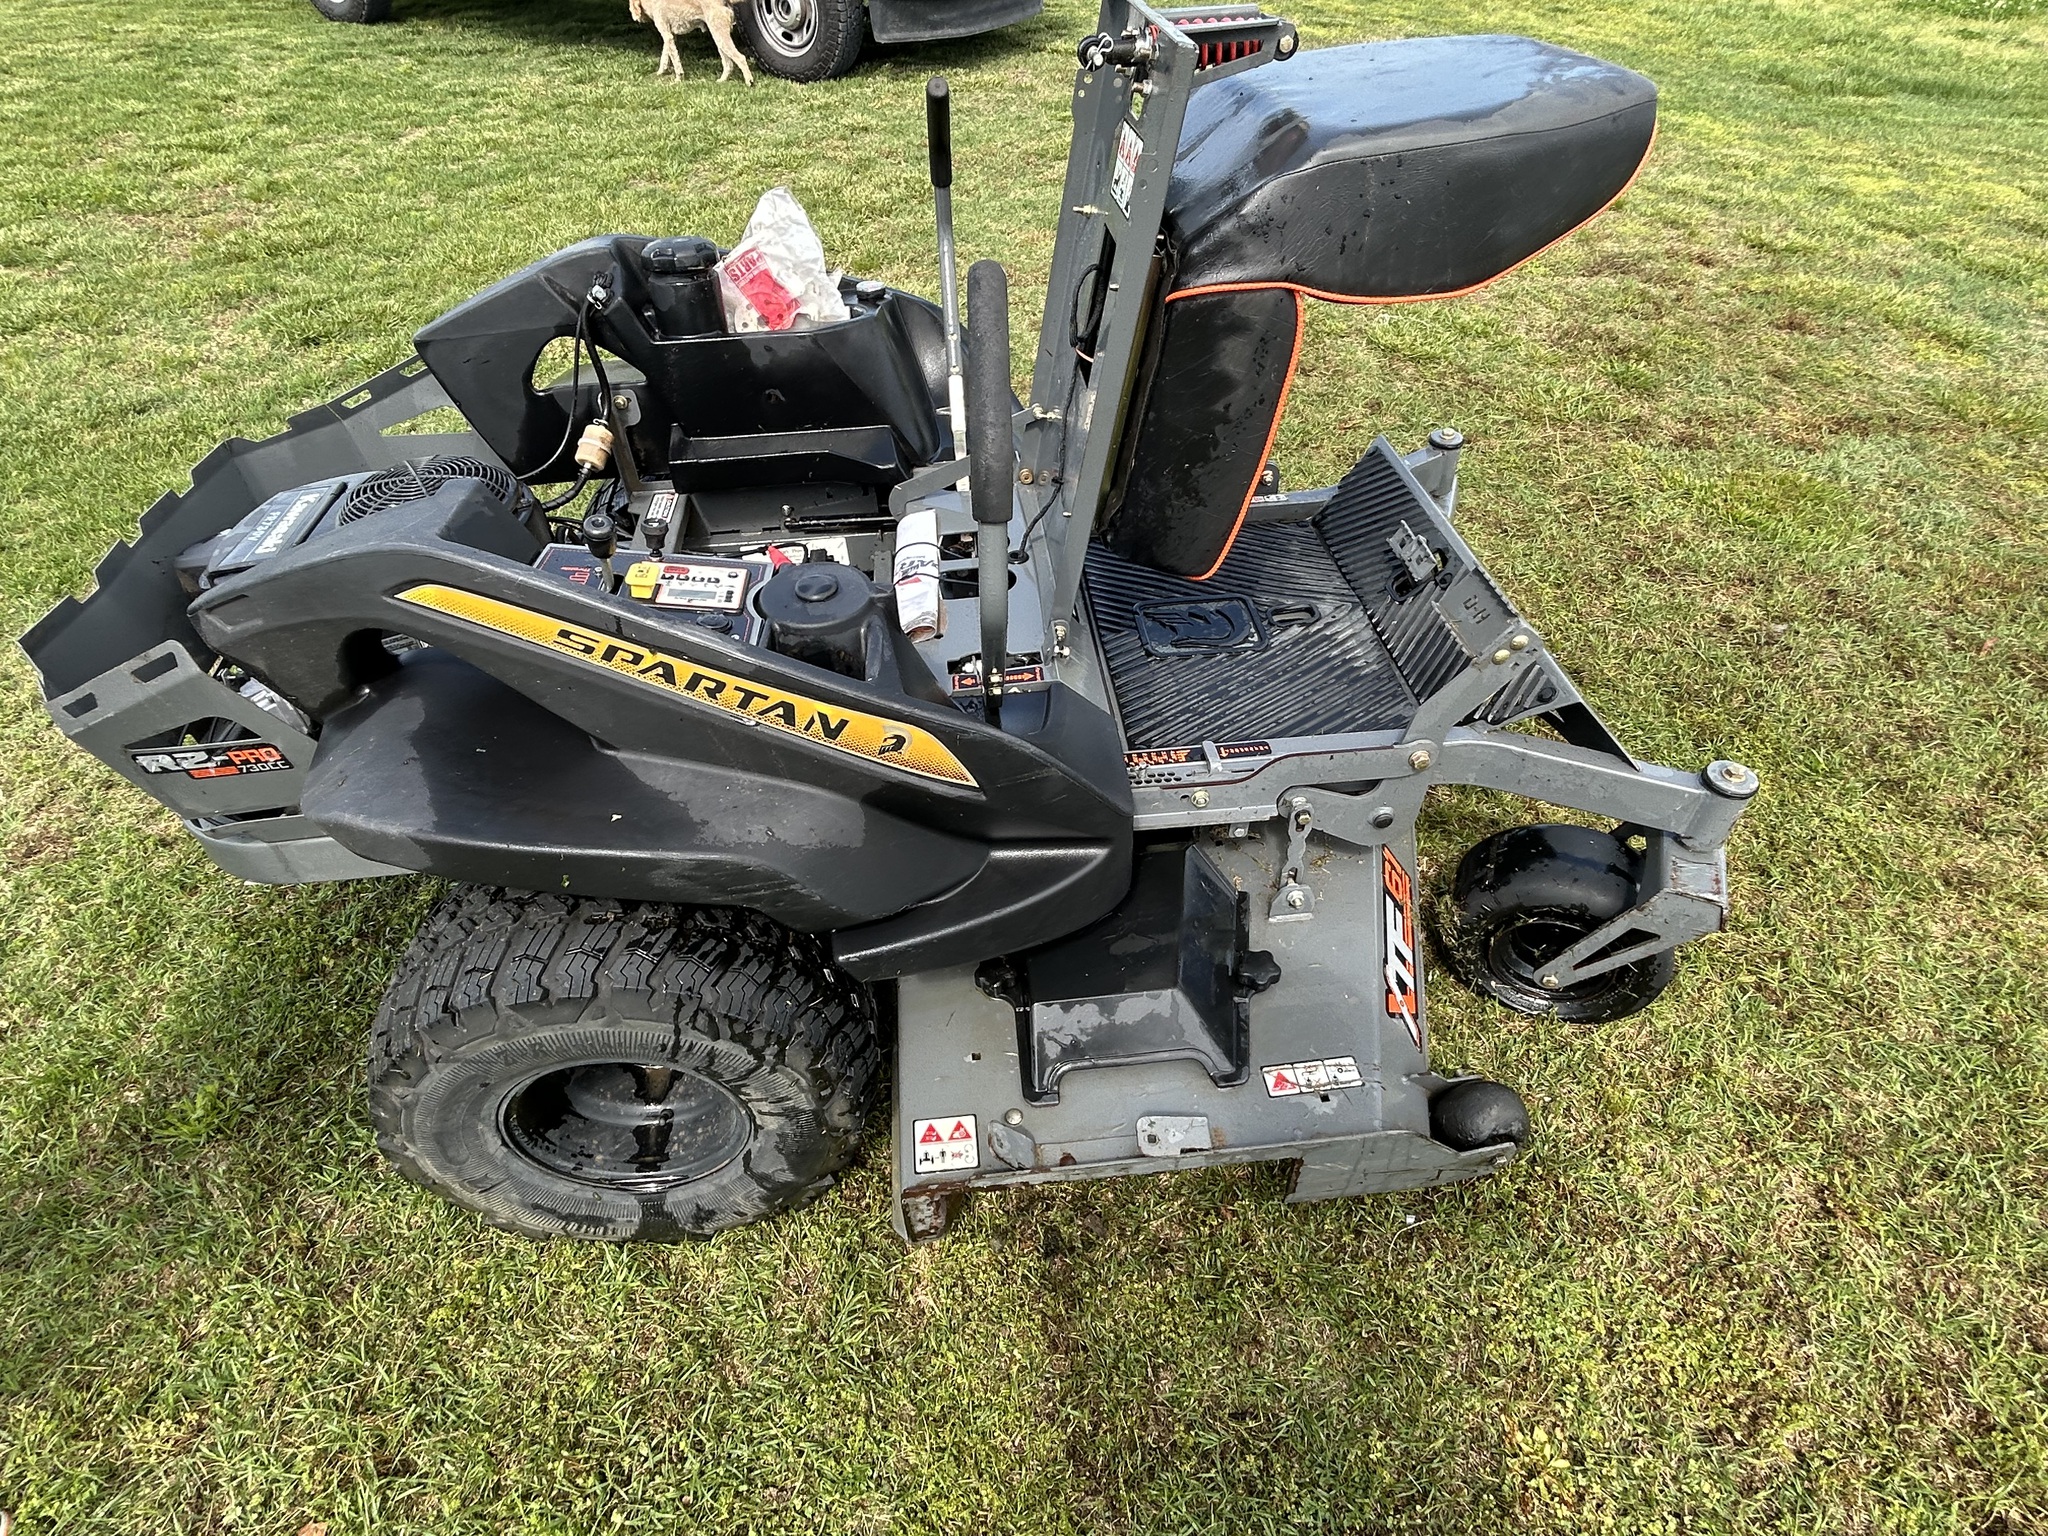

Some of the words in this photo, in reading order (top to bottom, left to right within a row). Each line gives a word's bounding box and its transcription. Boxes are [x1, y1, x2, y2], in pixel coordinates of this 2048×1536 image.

[728, 250, 764, 283] PARTS
[254, 492, 320, 555] Kawasaki
[552, 628, 850, 741] SPARTAN
[237, 760, 290, 773] 730CC
